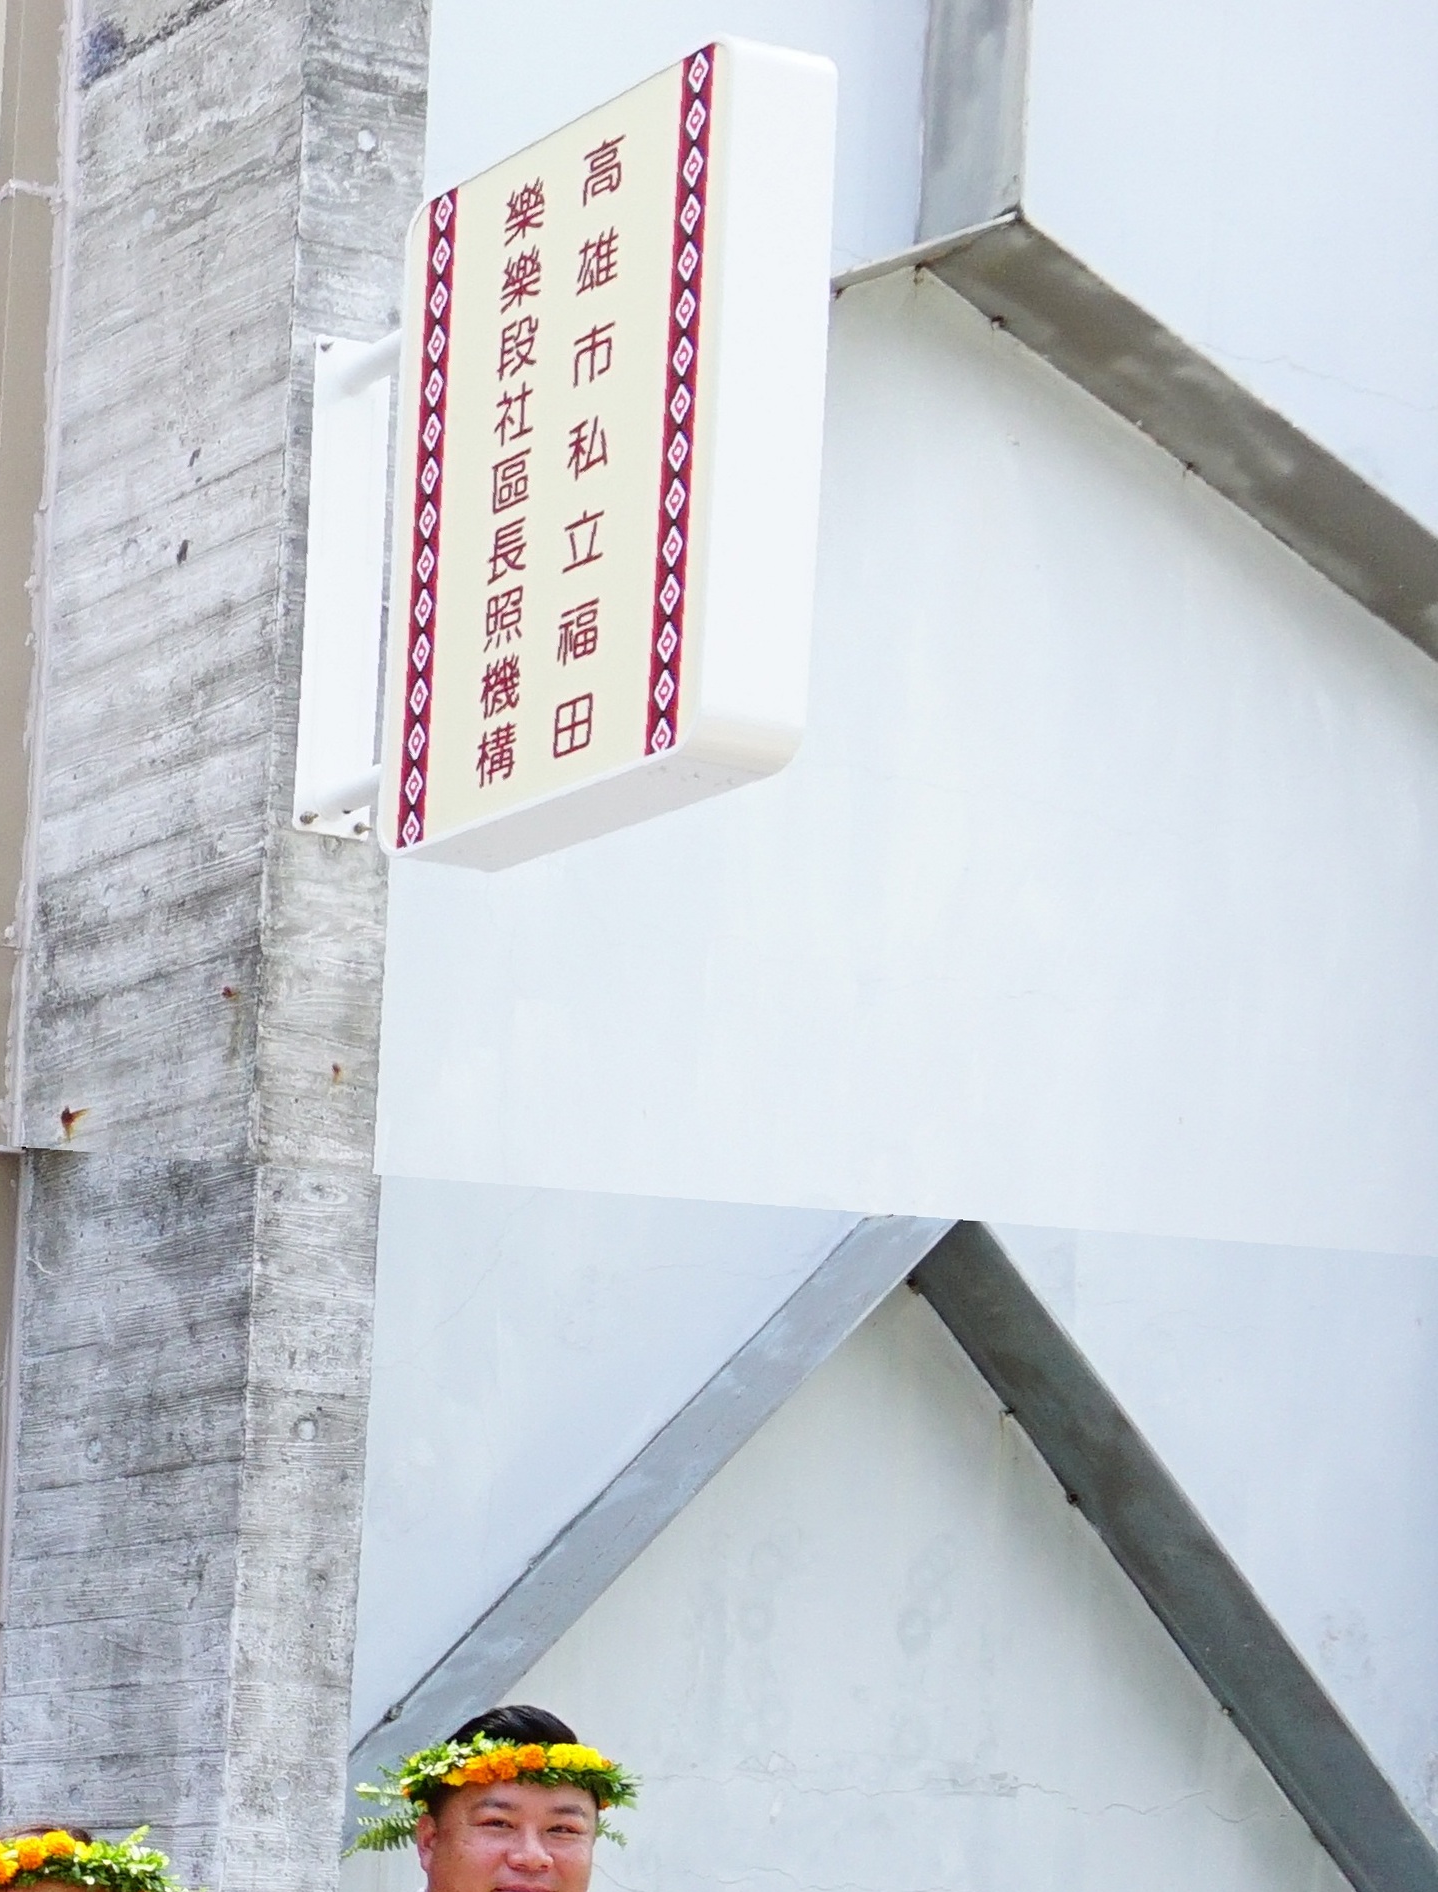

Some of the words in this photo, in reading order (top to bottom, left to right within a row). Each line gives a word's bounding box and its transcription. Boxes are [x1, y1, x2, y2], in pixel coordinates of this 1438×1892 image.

[475, 177, 545, 789] 樂樂段社區長照機構
[553, 134, 627, 760] 高雄市私立福田
